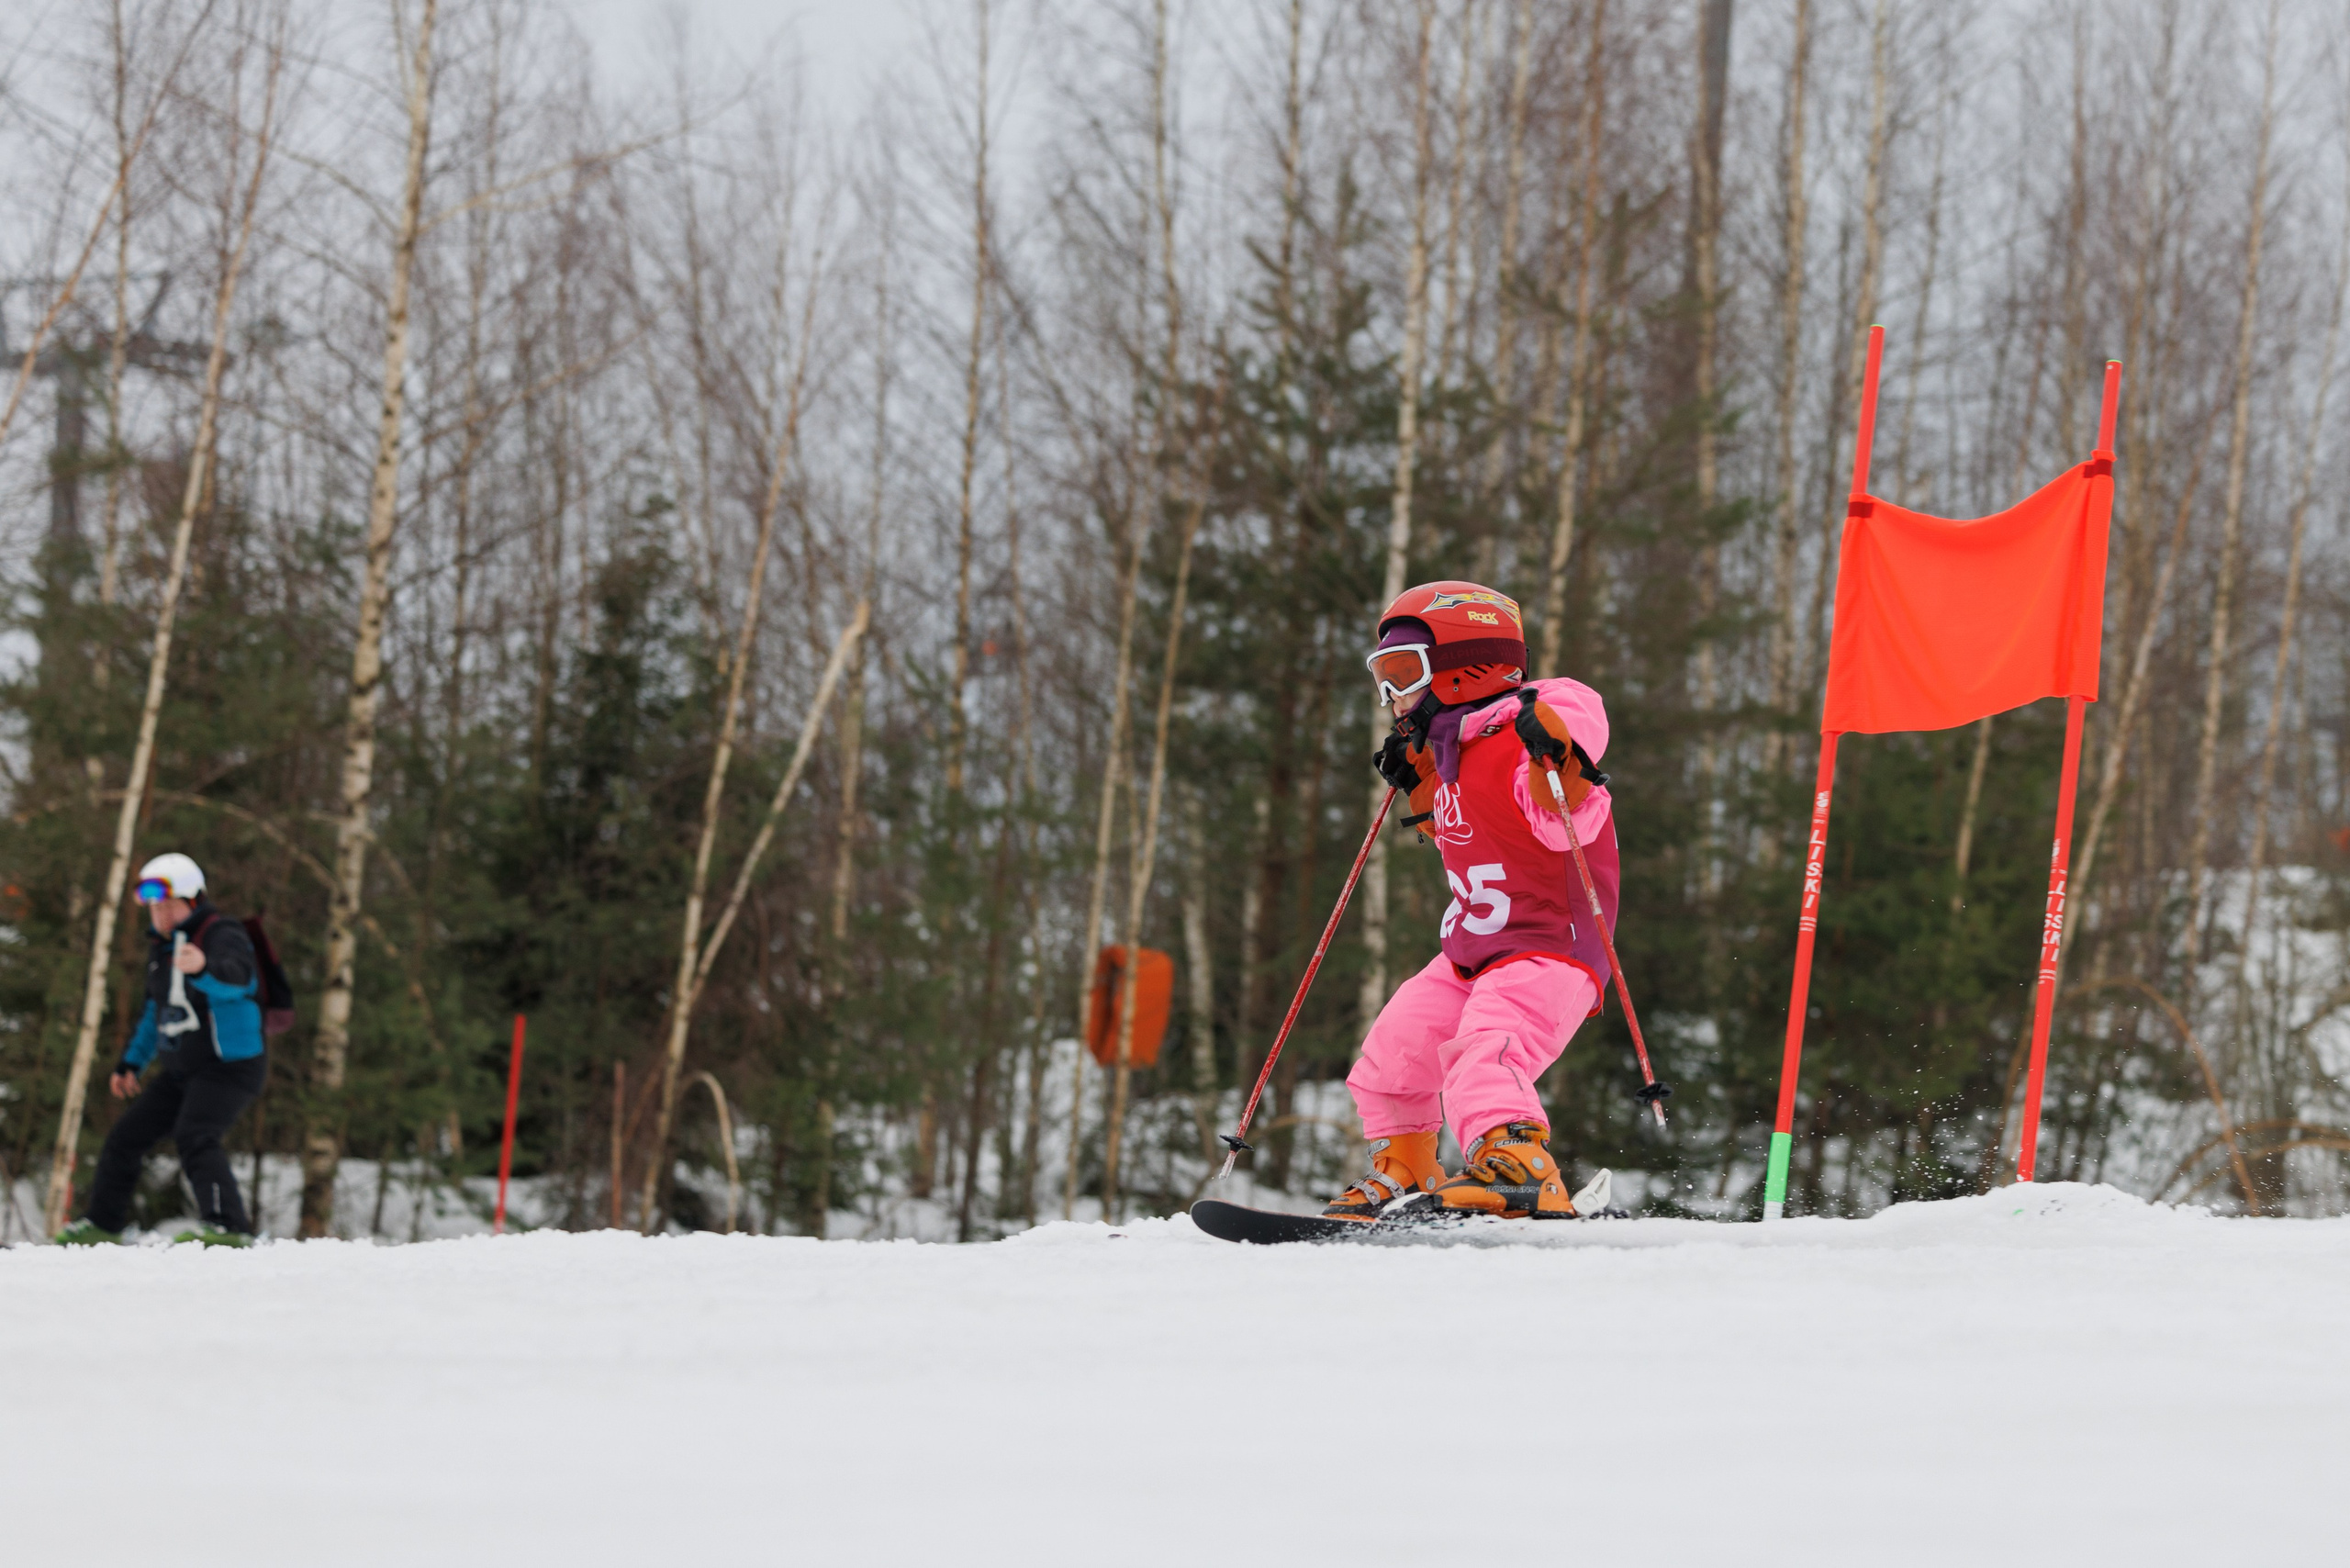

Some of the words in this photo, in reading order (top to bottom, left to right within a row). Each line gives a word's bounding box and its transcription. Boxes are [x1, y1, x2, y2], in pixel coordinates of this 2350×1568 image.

[1438, 647, 1492, 662] ALPINA
[1805, 829, 1825, 908] LISKI
[2050, 880, 2065, 962] LISKI
